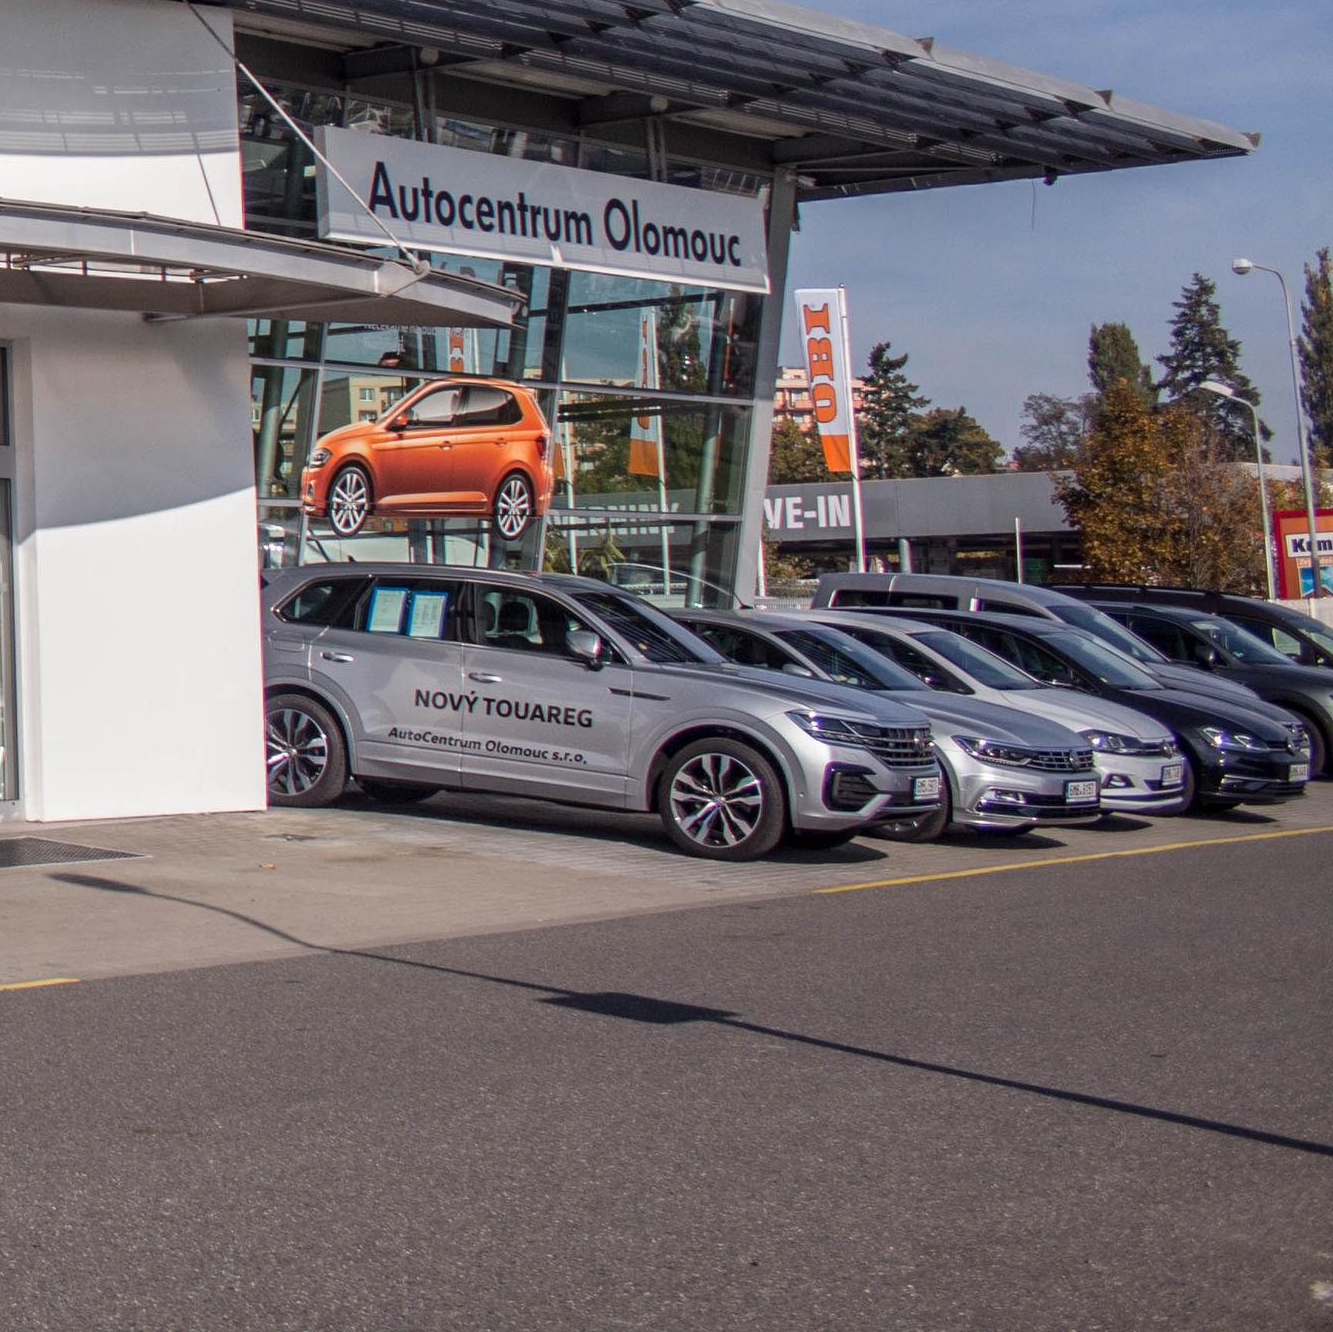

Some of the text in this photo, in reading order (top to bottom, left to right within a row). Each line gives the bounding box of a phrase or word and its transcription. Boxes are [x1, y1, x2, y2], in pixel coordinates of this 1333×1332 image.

[368, 161, 742, 266] Autocentrum Olomouc
[803, 302, 838, 424] OBI
[414, 688, 594, 728] NOVÝ TOUAREG
[388, 726, 588, 765] AutoCentrum Olomouc s.r.o.
